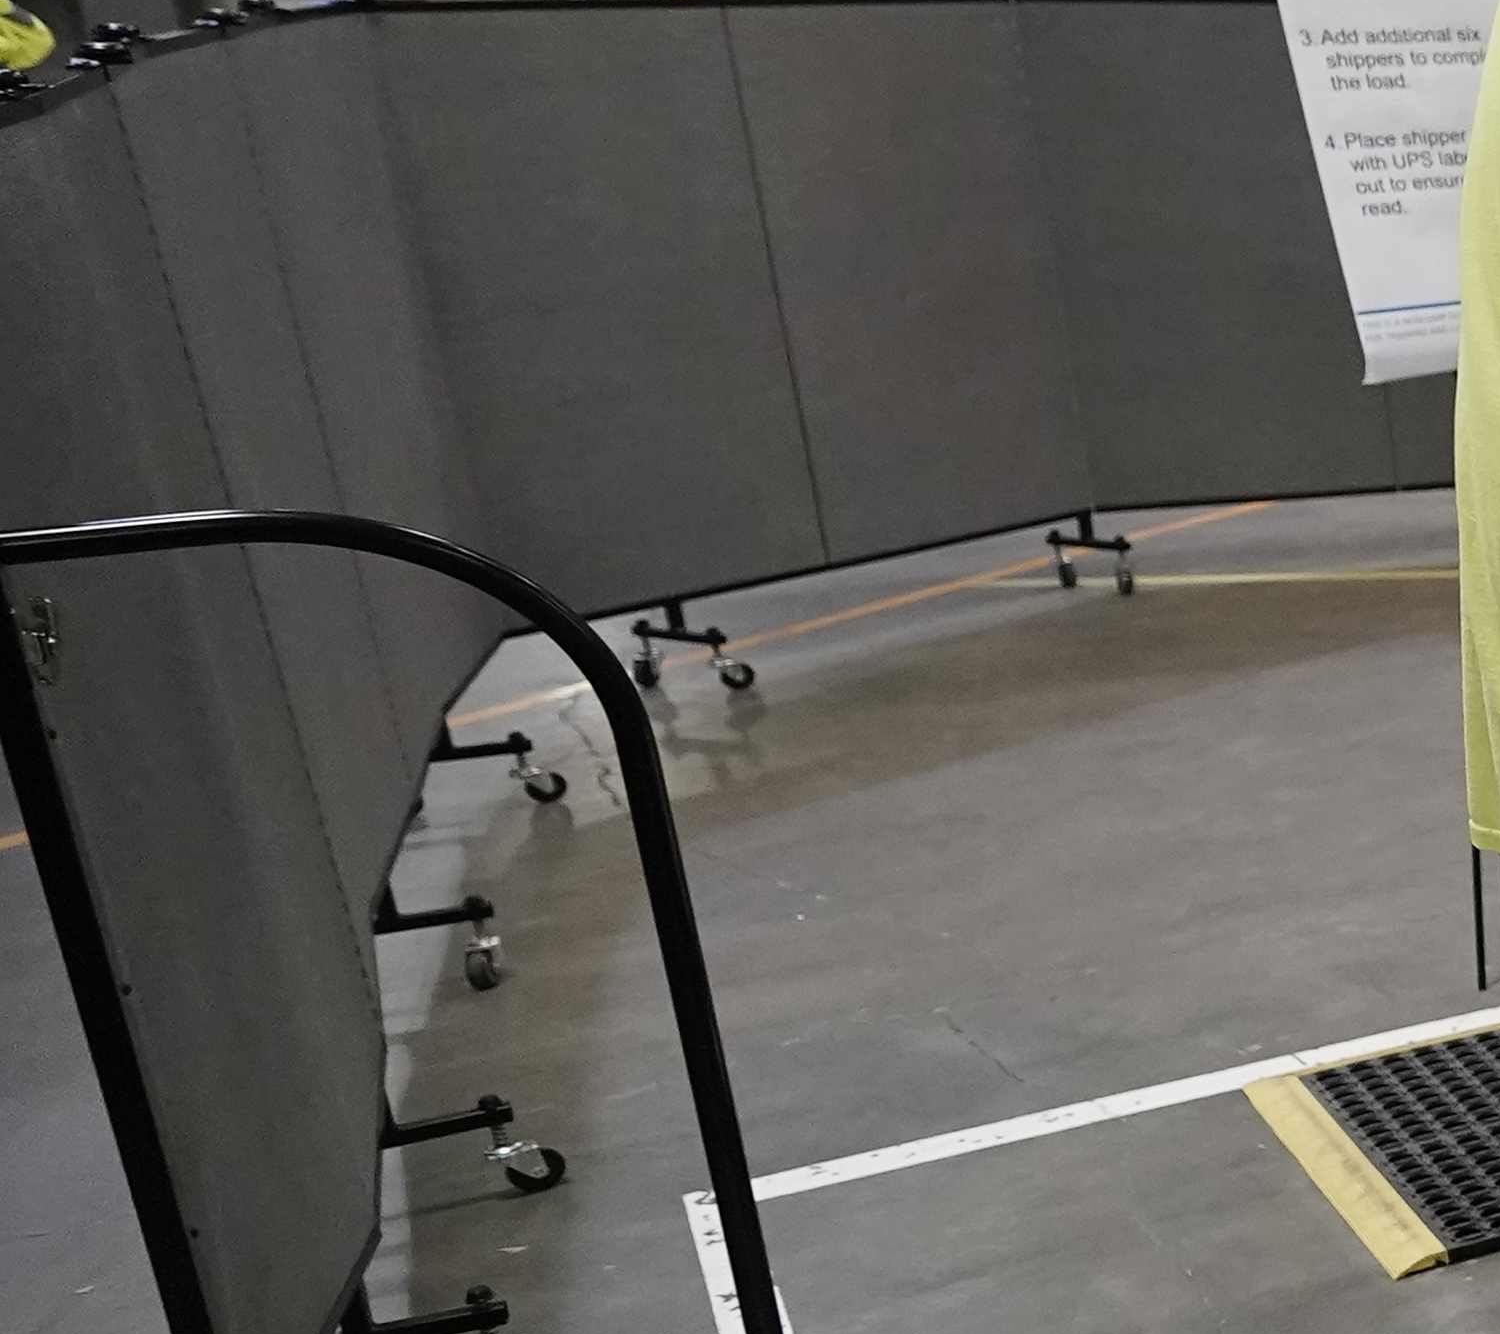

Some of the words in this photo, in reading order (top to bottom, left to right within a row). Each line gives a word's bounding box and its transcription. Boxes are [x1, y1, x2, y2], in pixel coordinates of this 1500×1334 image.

[1320, 28, 1359, 45] Add
[1365, 26, 1452, 44] additional
[1456, 26, 1482, 43] six
[1325, 52, 1405, 70] shippers
[1409, 51, 1427, 66] to
[1330, 74, 1361, 91] the
[1365, 73, 1410, 90] load.
[1343, 131, 1397, 150] Place
[1349, 154, 1389, 173] with
[1391, 149, 1435, 170] UPS
[1355, 178, 1386, 195] out
[1389, 175, 1407, 193] to
[1360, 200, 1409, 217] read.
